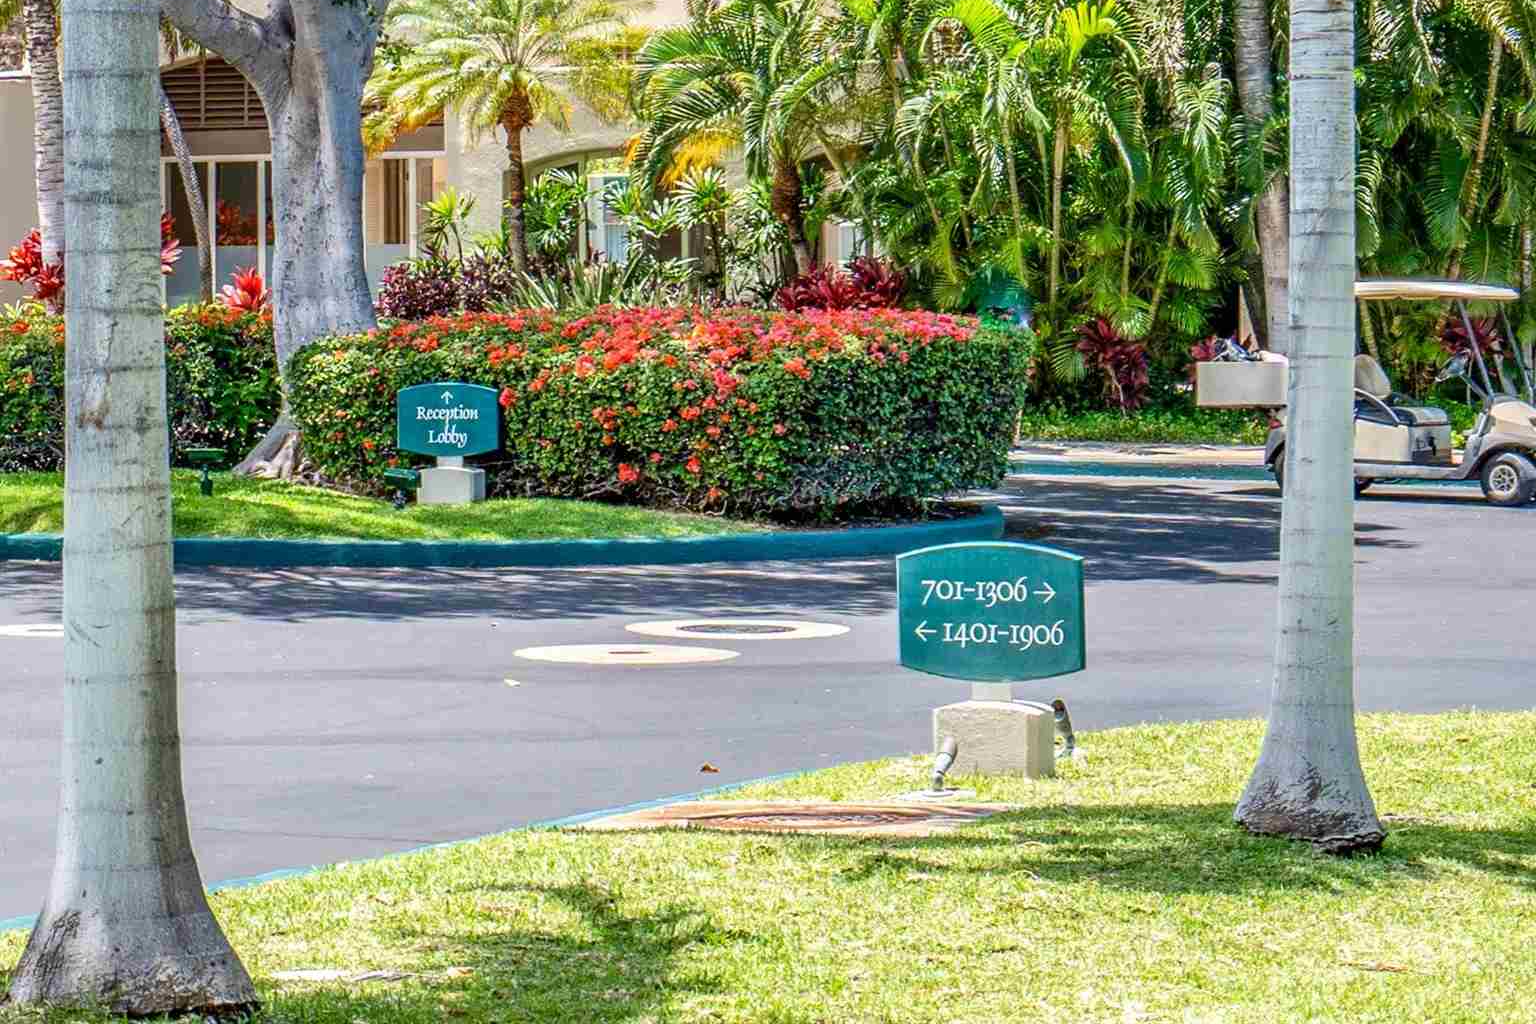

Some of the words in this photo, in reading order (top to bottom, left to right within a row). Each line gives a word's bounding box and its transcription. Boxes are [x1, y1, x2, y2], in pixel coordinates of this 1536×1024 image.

[416, 404, 479, 425] Reception
[428, 423, 468, 448] Lobby
[921, 576, 1028, 607] 701-1306
[943, 620, 1065, 650] 1401-1906
